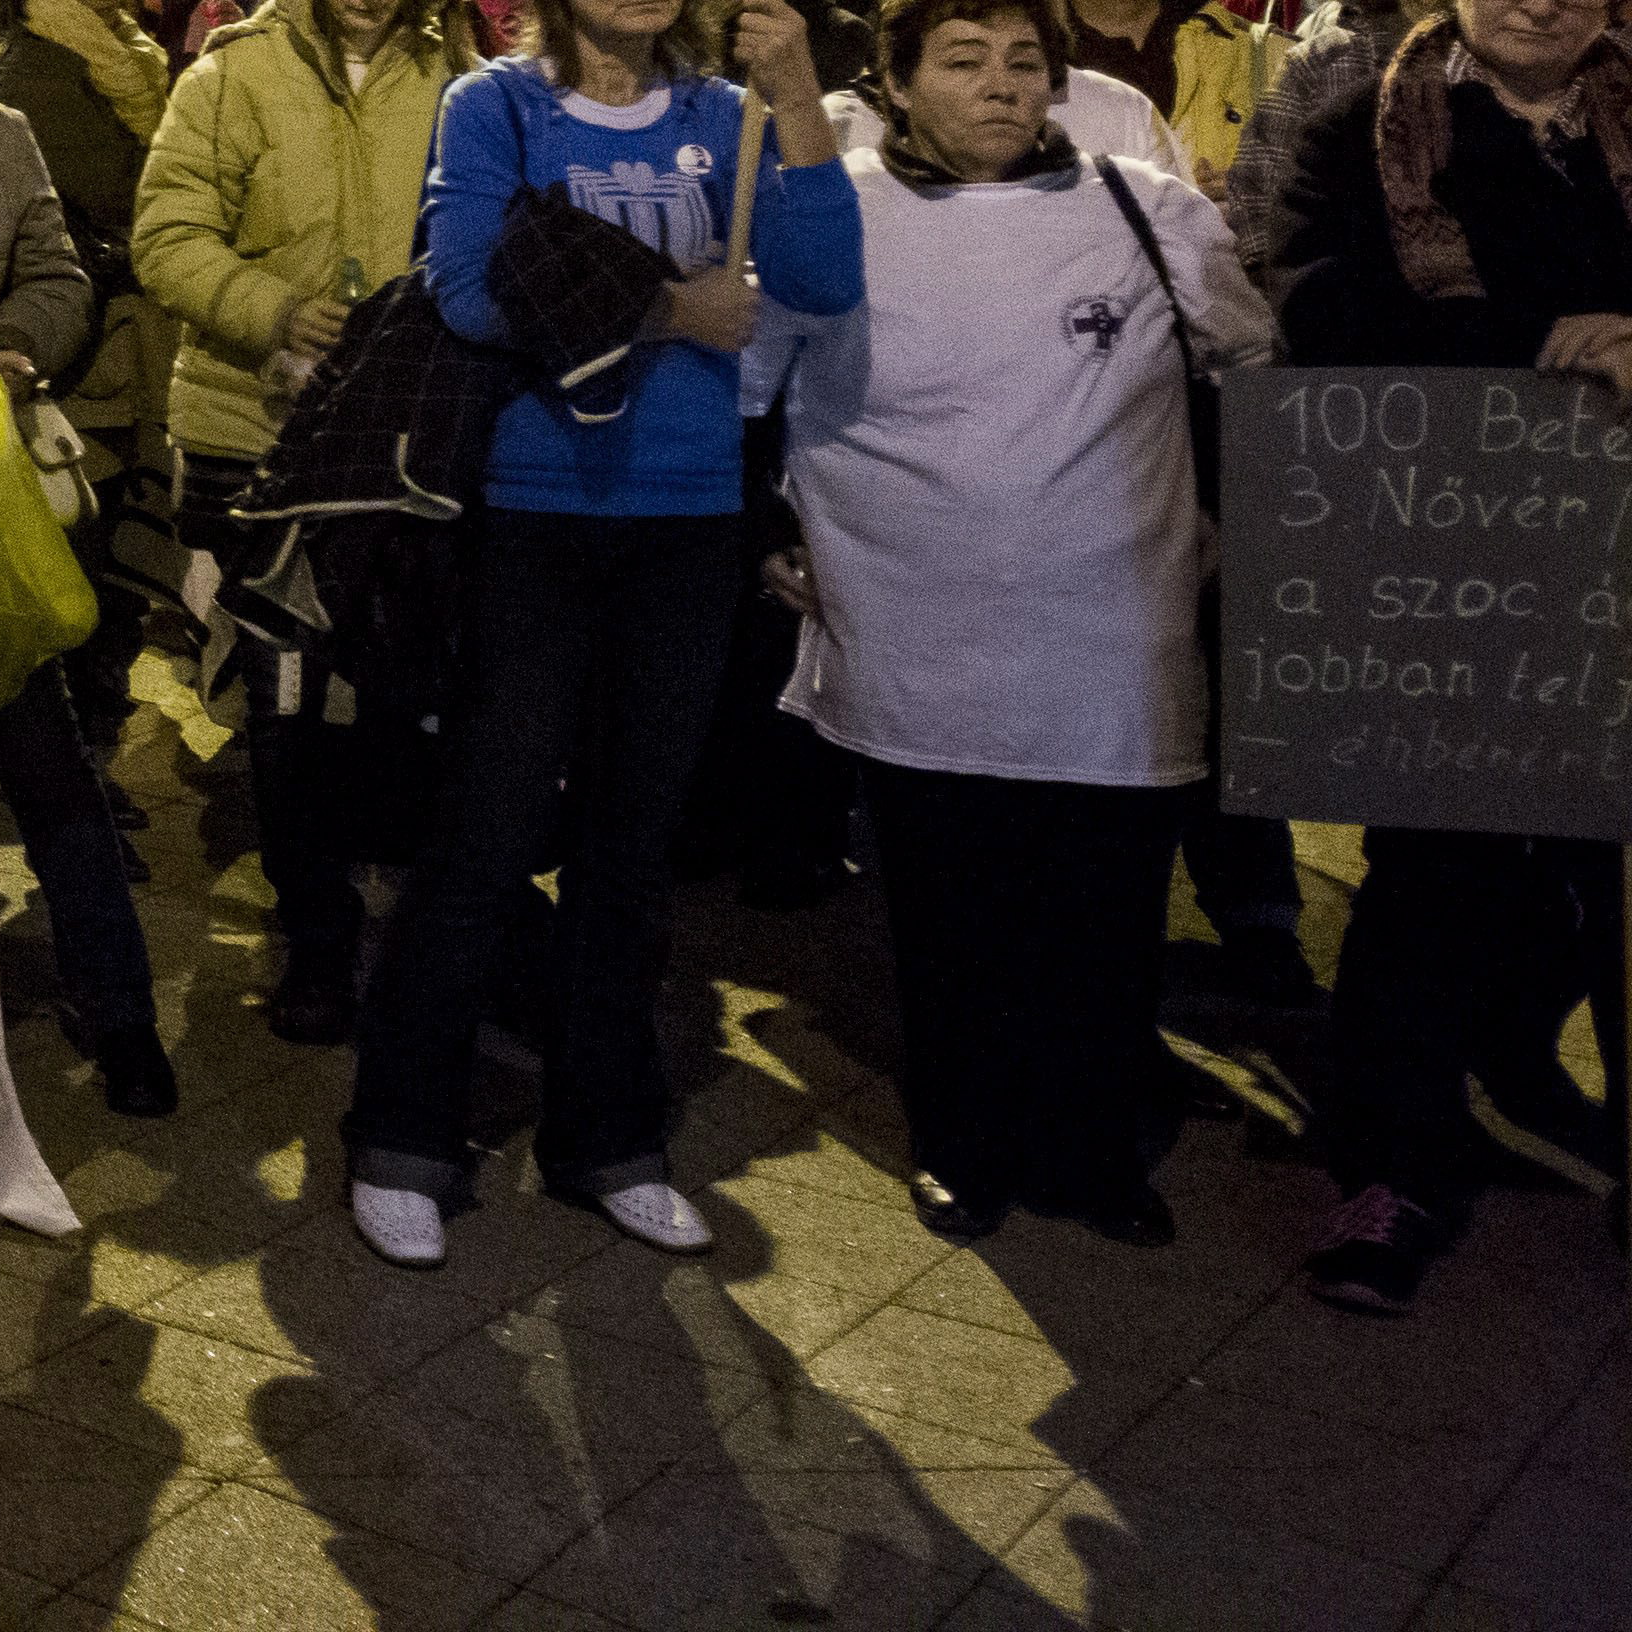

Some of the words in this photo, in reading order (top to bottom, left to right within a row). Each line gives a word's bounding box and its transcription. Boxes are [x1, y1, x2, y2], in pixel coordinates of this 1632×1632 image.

[1277, 381, 1428, 453] 100
[1276, 577, 1321, 616] a
[1243, 636, 1477, 702] jobban
